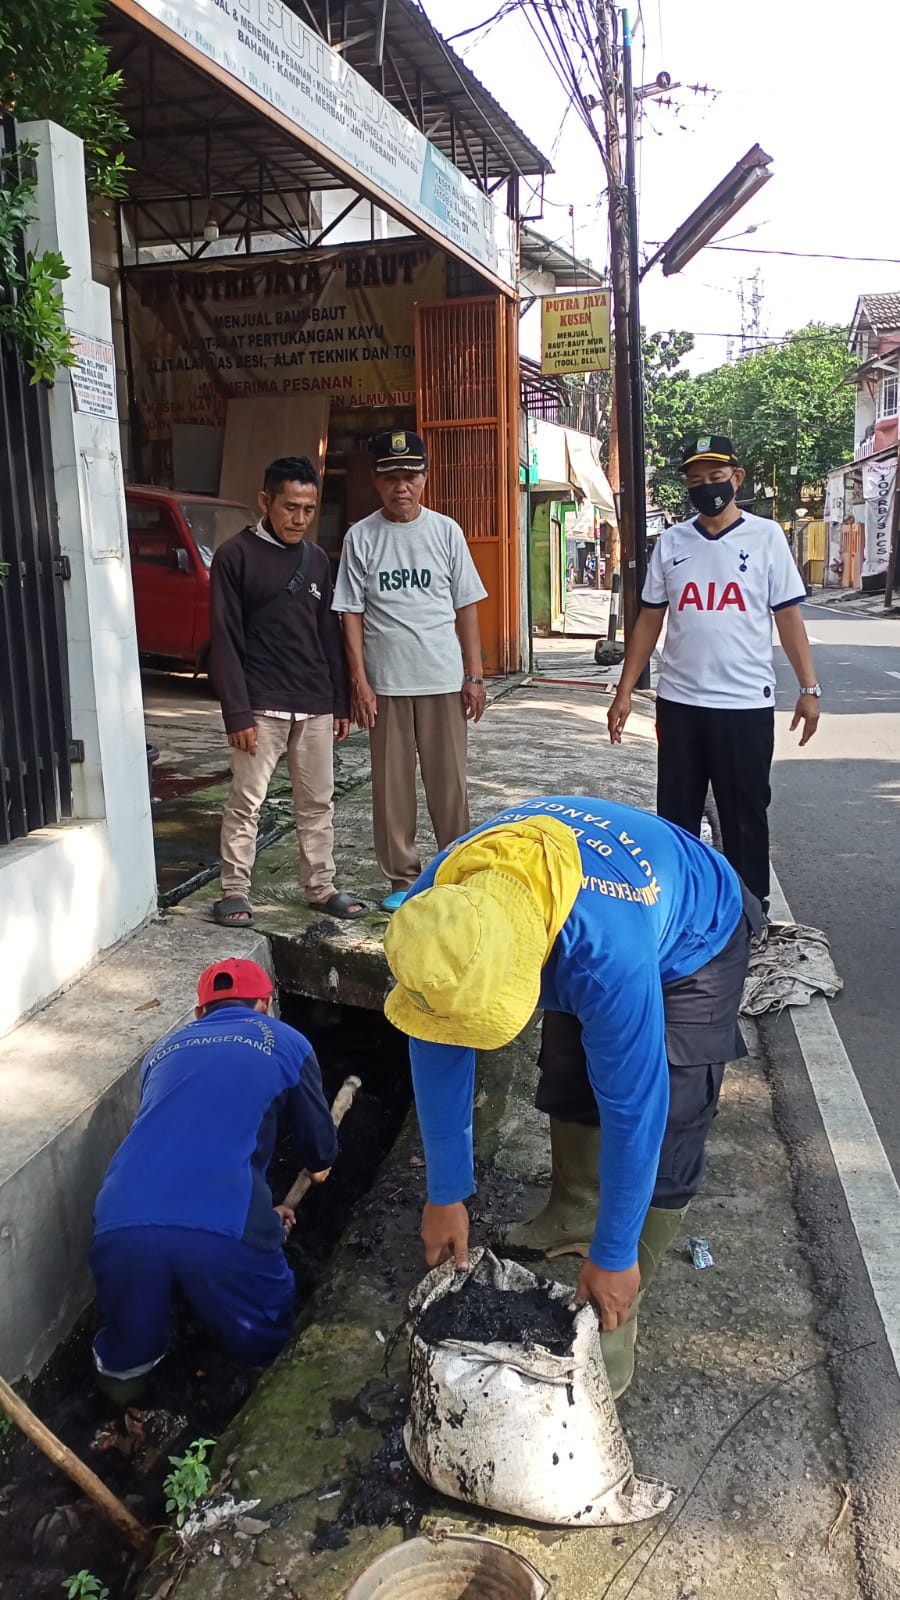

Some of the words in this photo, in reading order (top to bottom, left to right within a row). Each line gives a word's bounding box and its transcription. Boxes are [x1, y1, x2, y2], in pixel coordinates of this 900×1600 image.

[241, 15, 280, 57] MENERIMA
[282, 49, 311, 84] PESANAN
[316, 80, 337, 106] KUSEN
[361, 120, 384, 145] JENDELA
[237, 29, 270, 64] BAHAN
[278, 62, 314, 102] KAMPER,
[315, 94, 346, 126] MERBAU
[351, 125, 365, 145] JATI
[370, 139, 397, 167] MERANTI
[545, 298, 579, 312] PUTRA
[583, 294, 607, 310] JAYA
[214, 311, 272, 329] MENJUAL
[560, 312, 591, 327] KUSEN
[248, 327, 343, 348] PERTUKANGAN
[347, 325, 384, 341] KAYU
[547, 339, 584, 349] BAUT-BAUT
[587, 337, 603, 345] MUR
[557, 330, 588, 339] MENJUAL
[274, 351, 305, 367] ALAT
[309, 346, 359, 364] TEKNIK
[362, 344, 389, 360] DAN
[544, 349, 579, 359] ALAT-ALAT
[283, 374, 353, 392] PESANAN
[379, 568, 431, 592] RSPAD
[678, 581, 747, 611] AIA
[150, 1043, 180, 1066] KOTA
